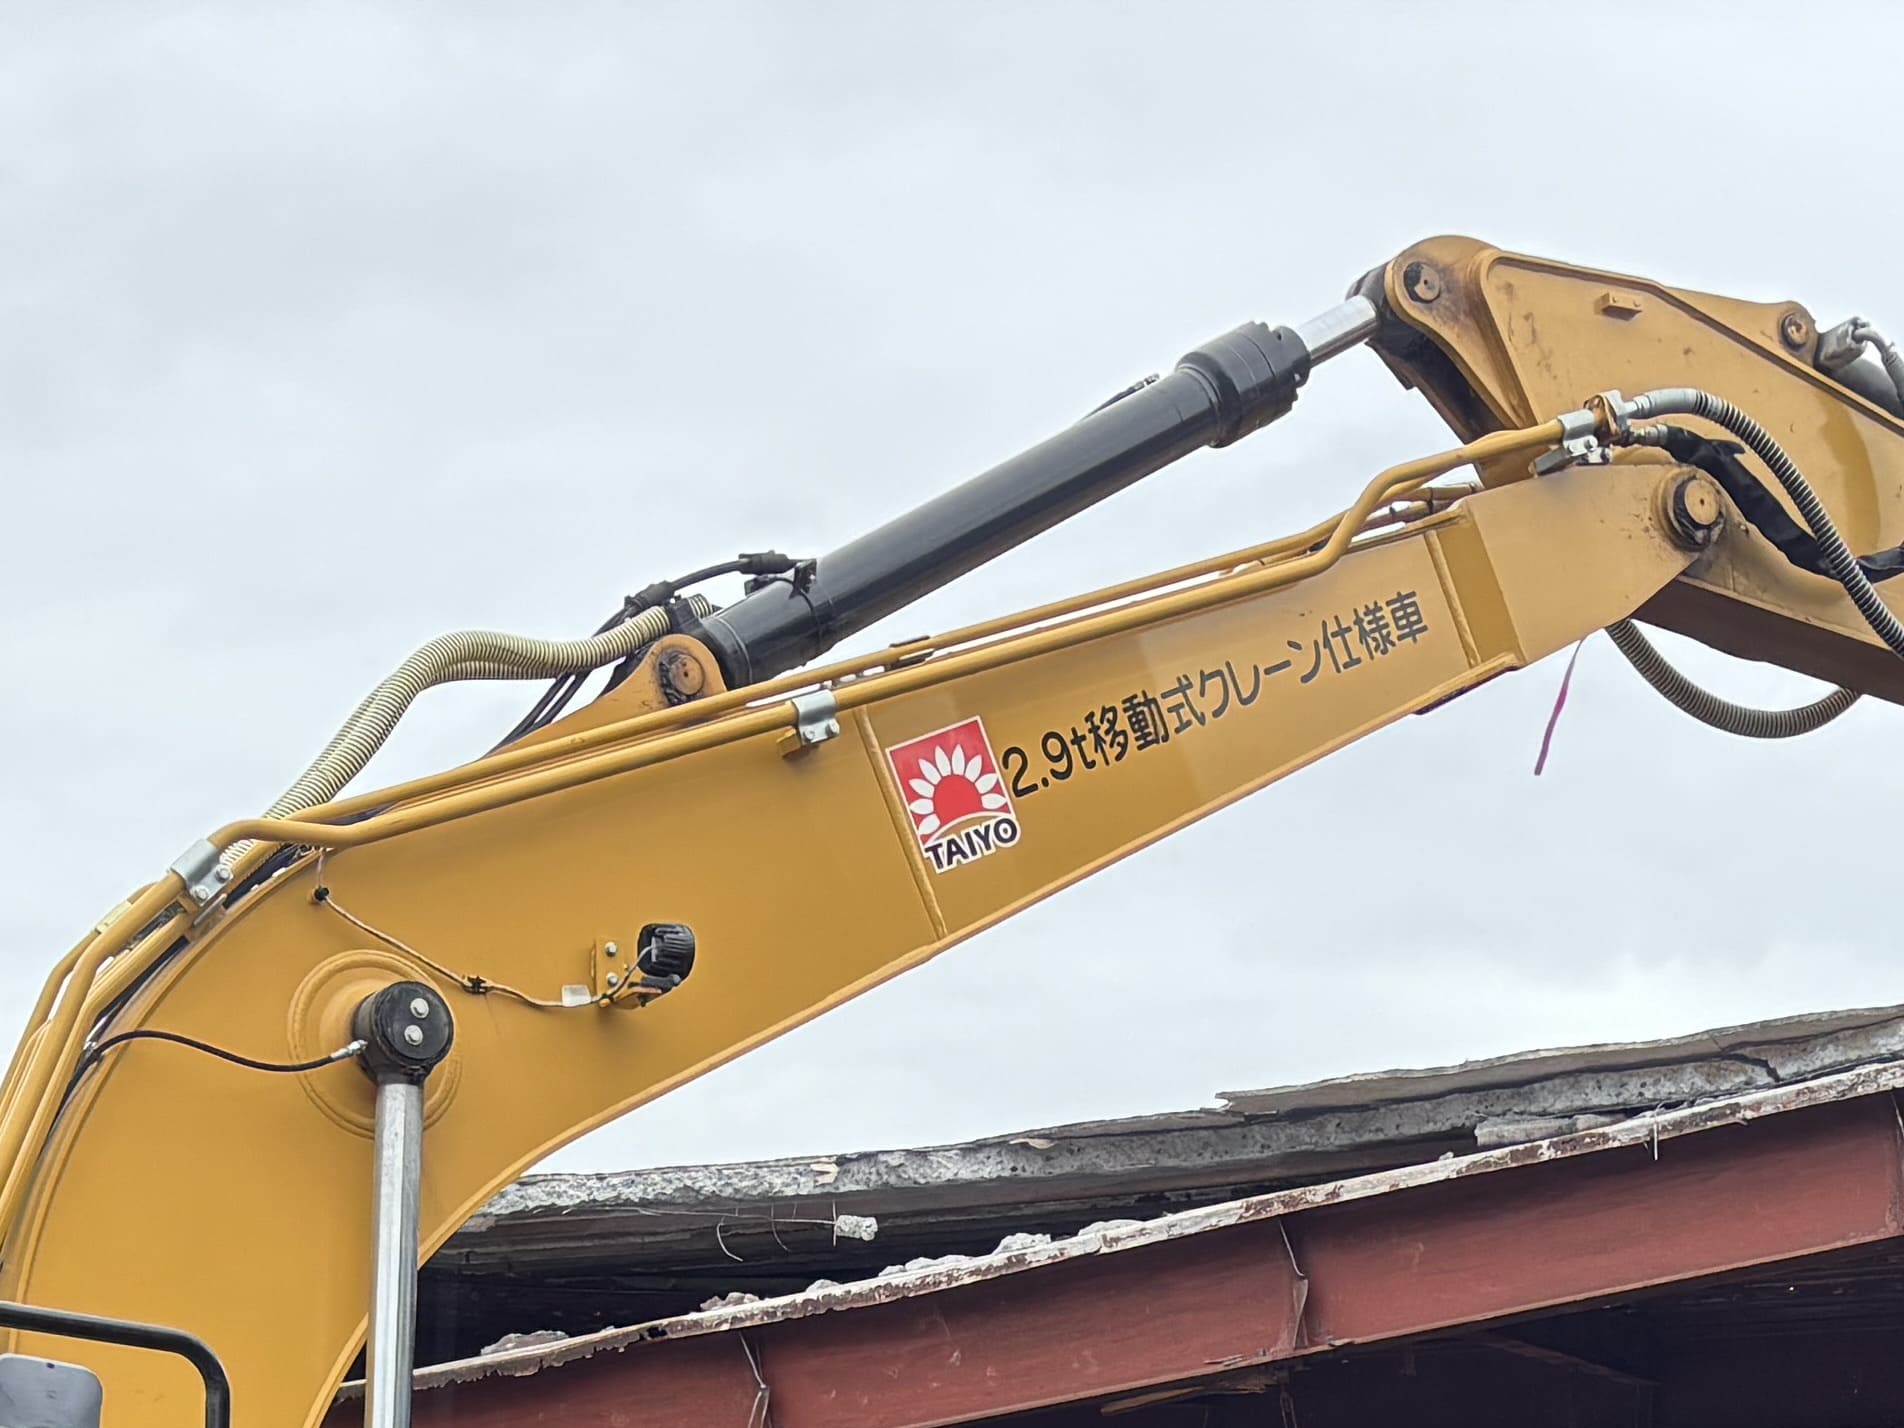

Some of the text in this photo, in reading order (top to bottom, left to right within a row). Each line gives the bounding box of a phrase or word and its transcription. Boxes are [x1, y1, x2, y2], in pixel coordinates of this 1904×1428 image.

[1001, 590, 1429, 799] 2.9t移動式クレーン仕様車
[925, 815, 1020, 872] TAIYO
